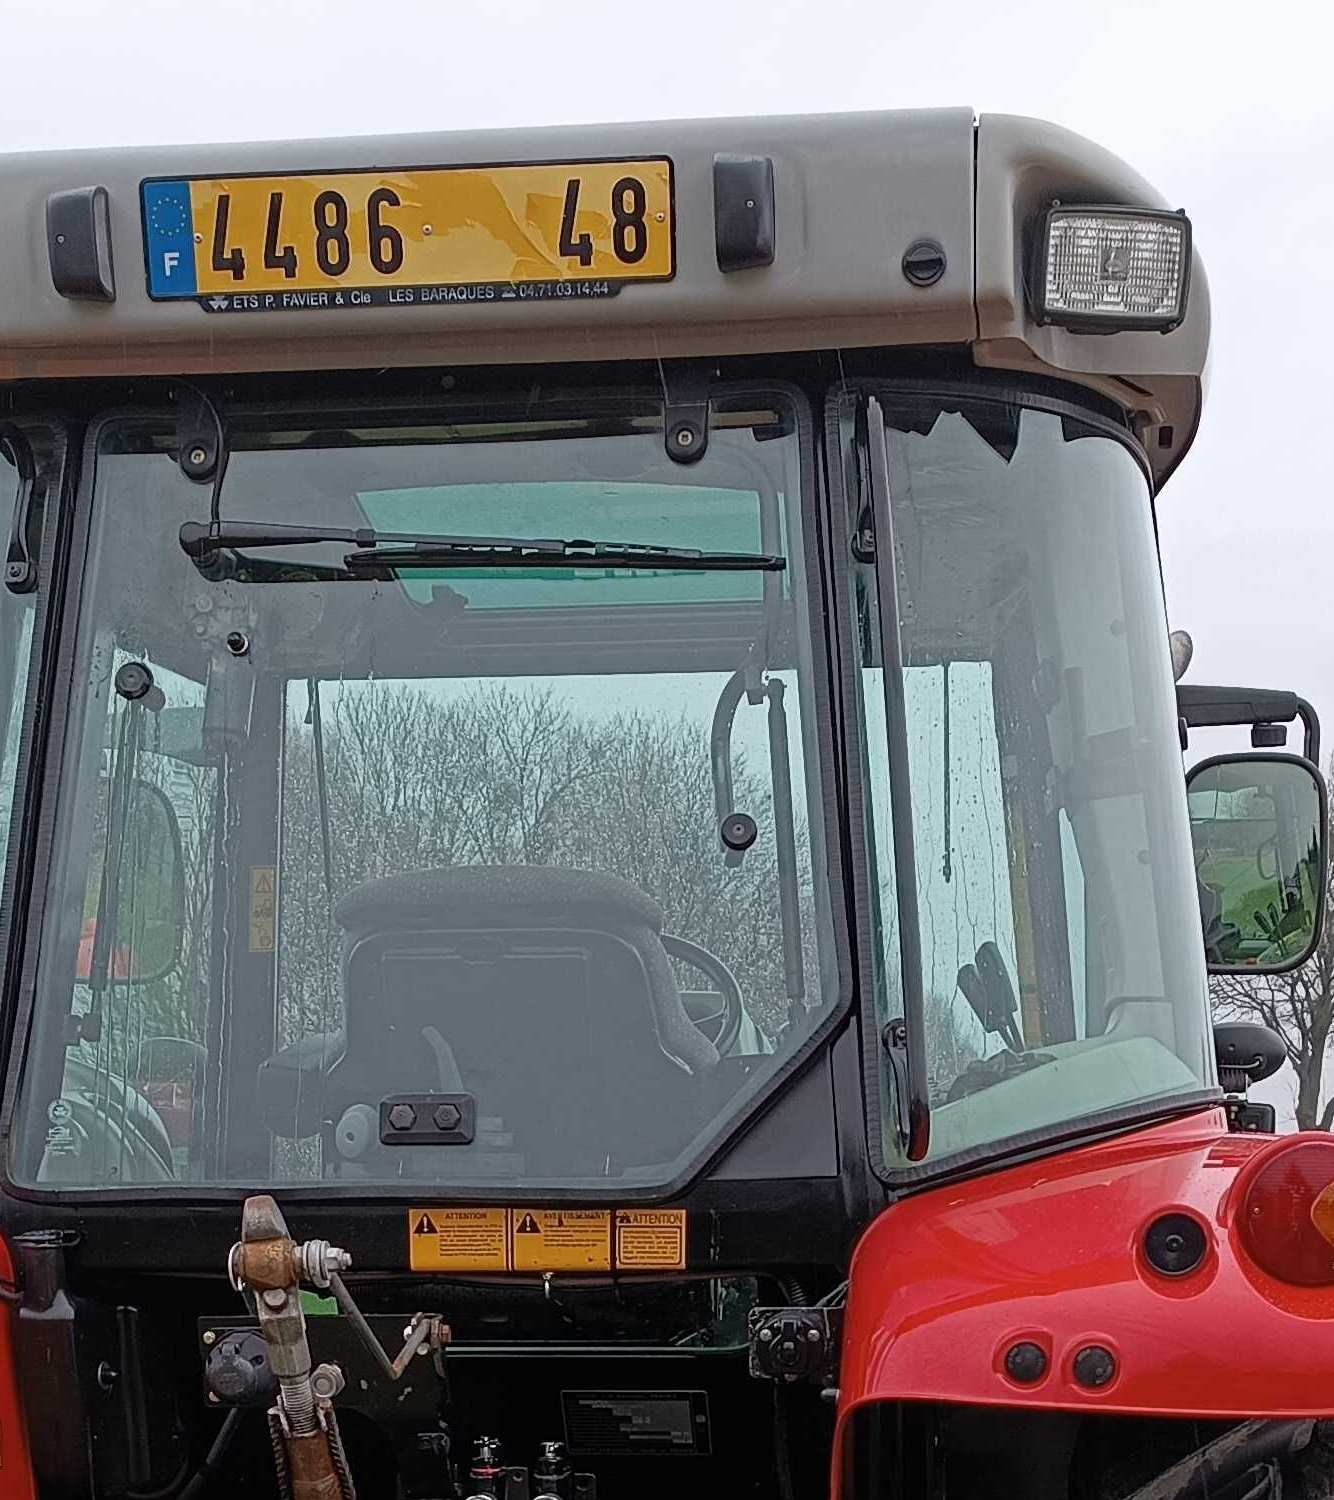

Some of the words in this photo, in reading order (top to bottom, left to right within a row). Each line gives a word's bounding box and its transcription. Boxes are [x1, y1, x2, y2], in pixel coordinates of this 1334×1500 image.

[210, 187, 405, 282] 4486
[558, 176, 650, 268] 48
[163, 251, 180, 277] F
[233, 295, 259, 309] ETS
[282, 292, 329, 307] FAVIER
[334, 291, 345, 305] &
[350, 290, 372, 304] Cie
[388, 287, 414, 303] LES
[421, 285, 495, 302] BARAQUES
[444, 1212, 487, 1220] ATTENTION
[632, 1213, 683, 1225] ATTENTION
